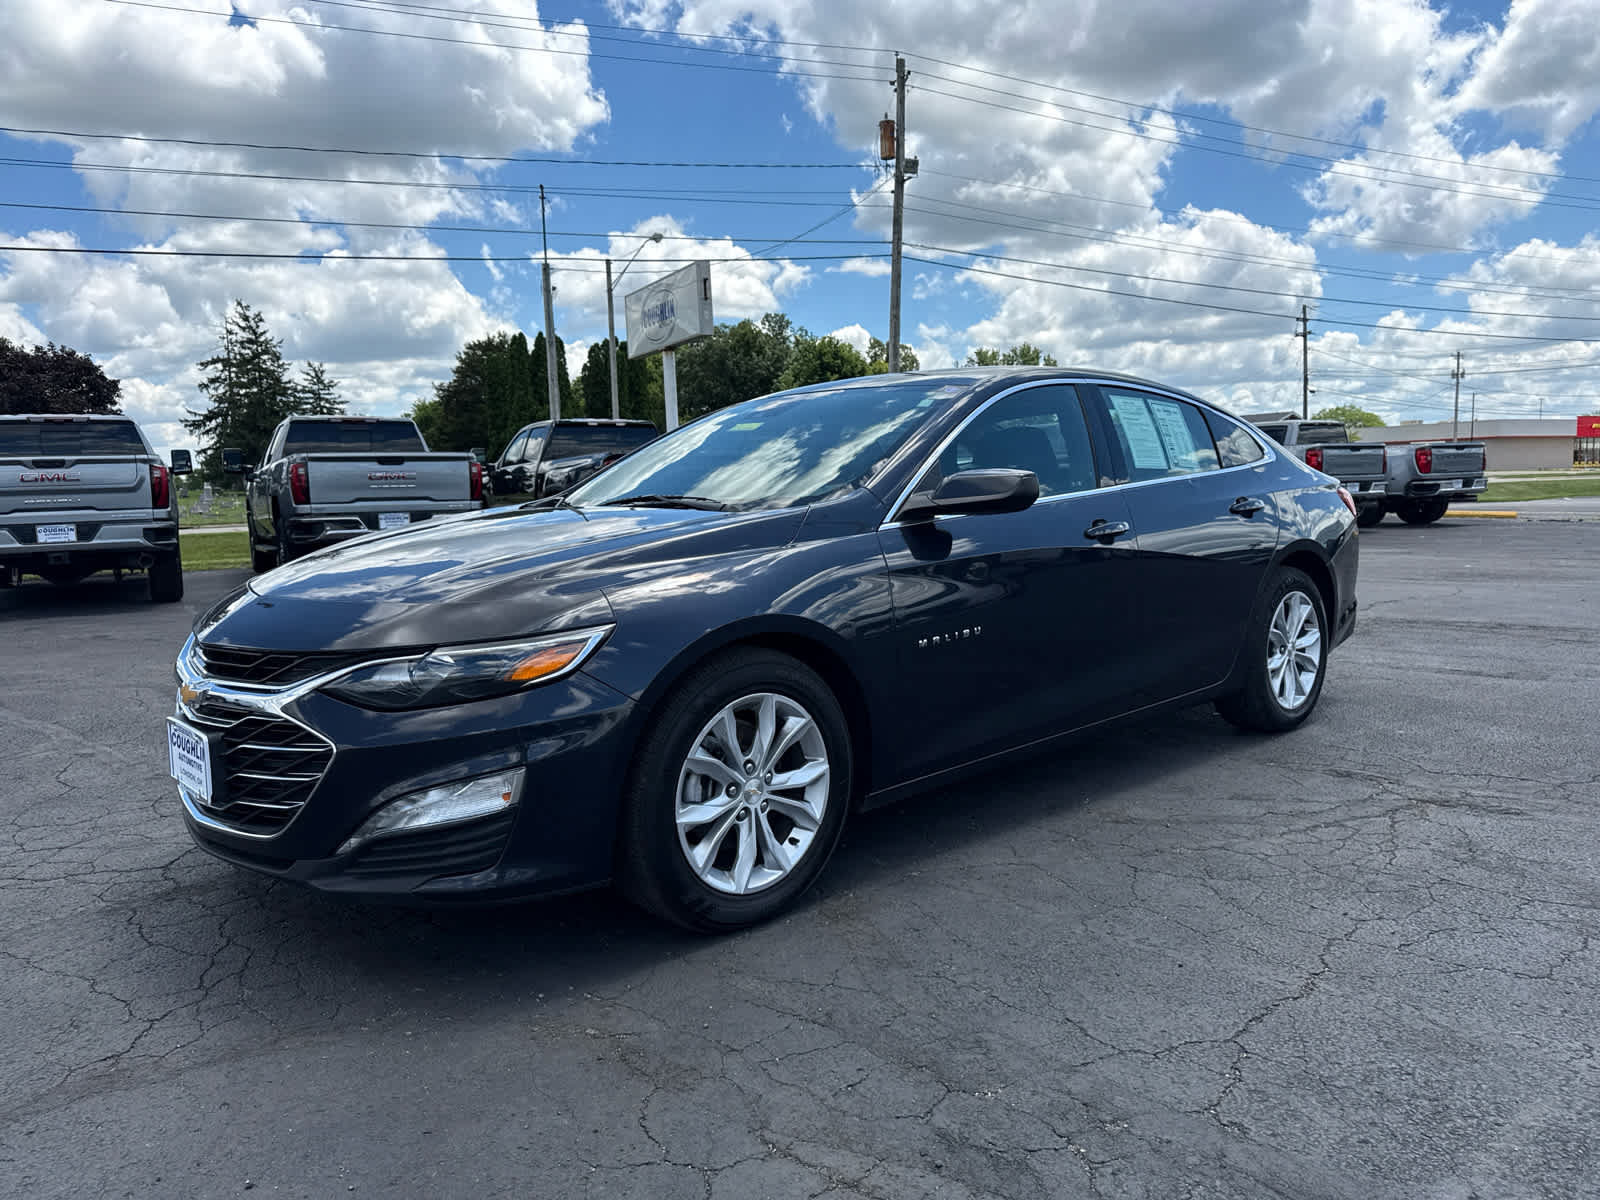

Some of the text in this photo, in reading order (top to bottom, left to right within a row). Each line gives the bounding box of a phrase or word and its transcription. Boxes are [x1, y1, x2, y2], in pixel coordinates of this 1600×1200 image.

[20, 472, 81, 482] GMC
[368, 472, 417, 481] GMC
[918, 625, 982, 648] MALIBU
